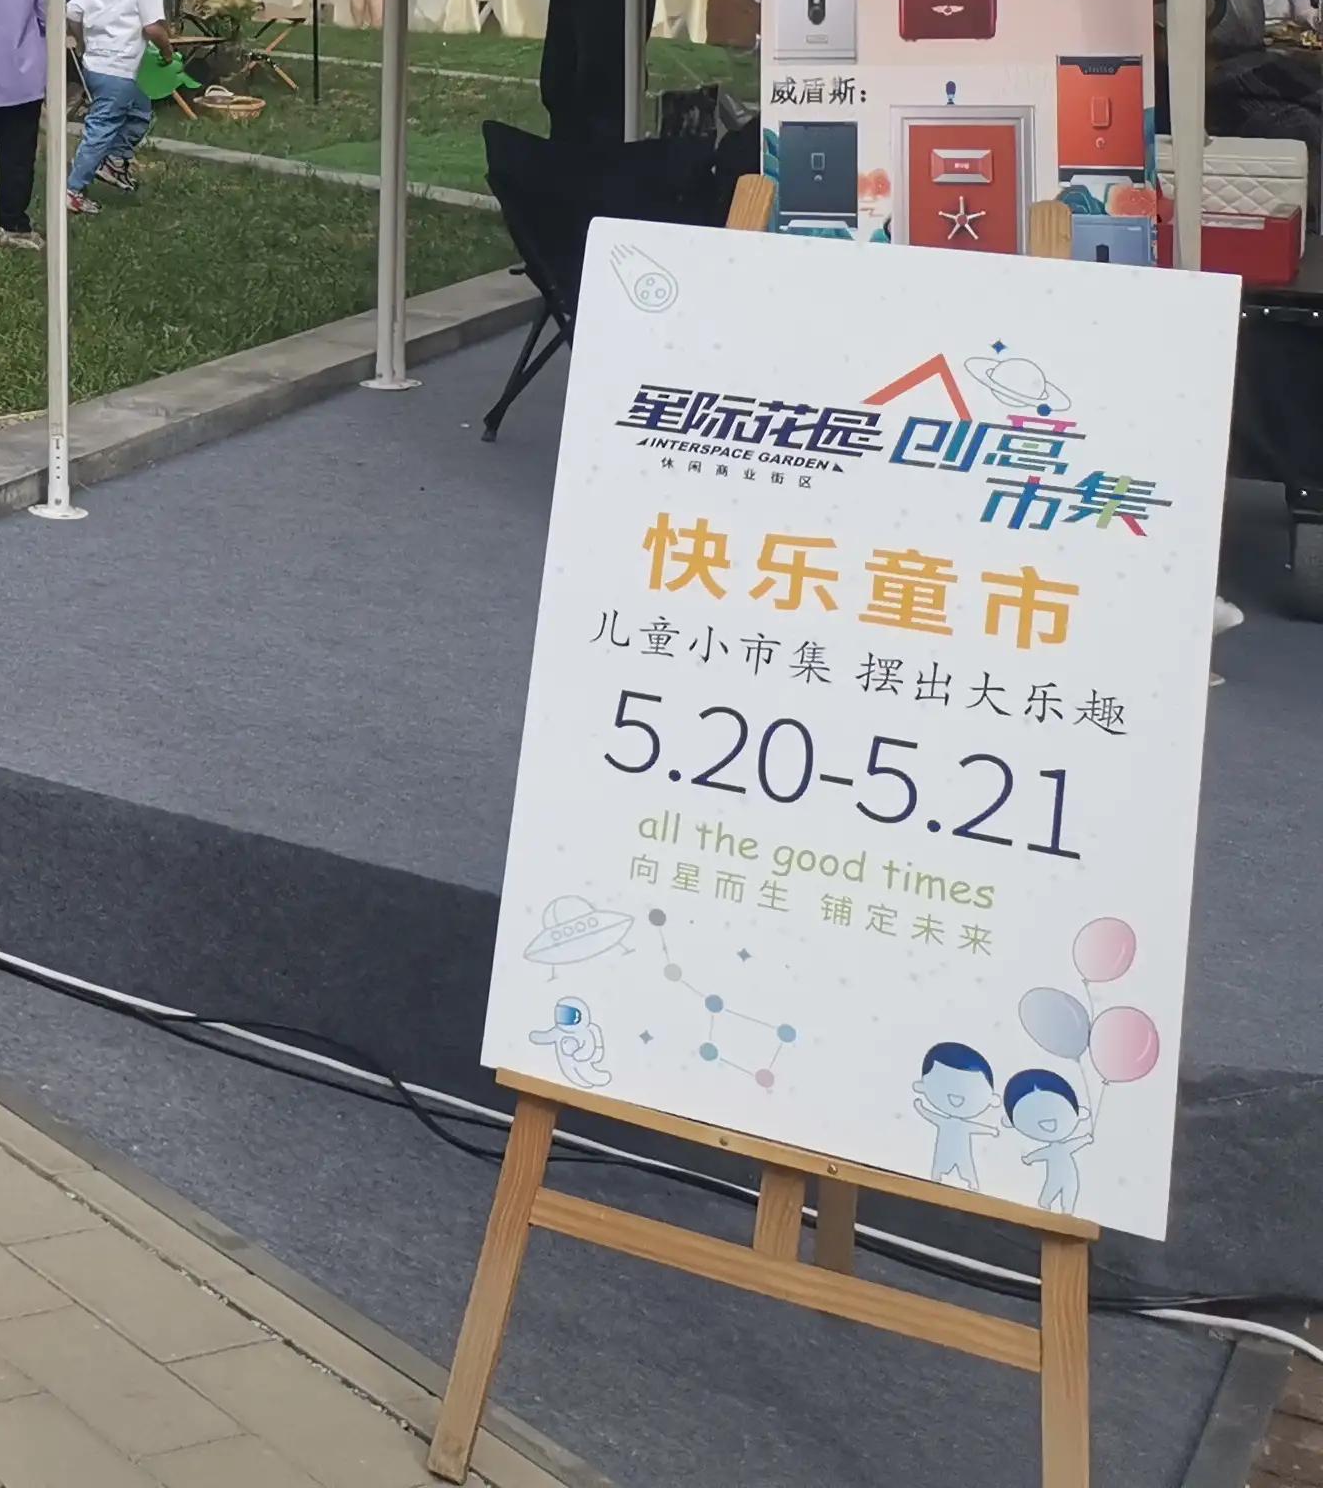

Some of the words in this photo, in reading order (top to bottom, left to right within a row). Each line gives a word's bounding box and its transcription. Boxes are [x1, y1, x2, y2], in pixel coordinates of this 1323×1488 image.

[615, 384, 885, 458] 星际花园
[649, 437, 755, 462] INTERSPACE
[757, 451, 830, 472] GARDEN
[660, 456, 812, 489] 休闲商业街区
[980, 470, 1173, 537] 市集
[642, 512, 1080, 650] 快乐童市
[588, 609, 833, 684] 儿童小市集
[855, 651, 1129, 737] 摆出大乐趣
[603, 689, 1082, 861] 5.20-5.21
[629, 854, 790, 913] 向星而生
[819, 893, 993, 957] 铺定未来
[638, 810, 681, 844] all
[695, 822, 760, 861] the
[771, 845, 867, 883] good
[881, 859, 996, 910] times
